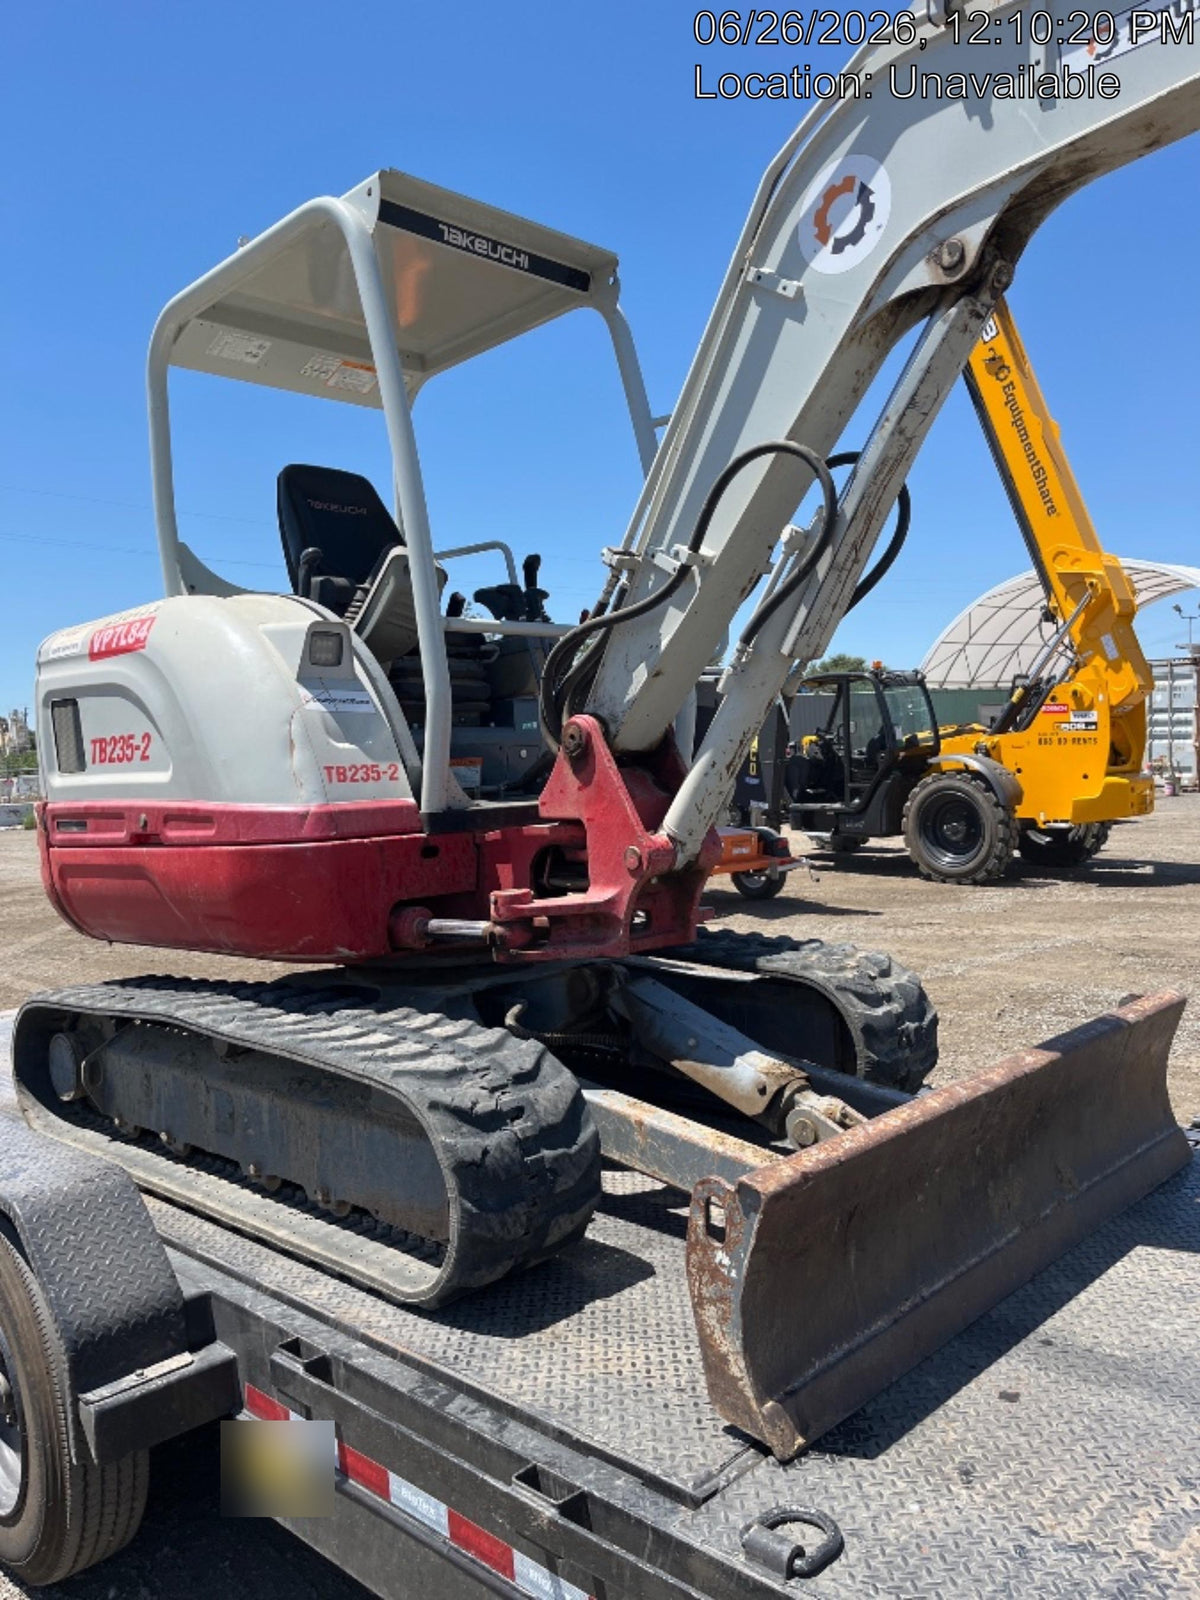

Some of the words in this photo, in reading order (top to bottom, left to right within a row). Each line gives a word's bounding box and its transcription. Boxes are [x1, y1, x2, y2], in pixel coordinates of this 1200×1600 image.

[1002, 381, 1057, 517] EquipmentShare
[90, 732, 152, 765] TB235-2
[322, 763, 400, 784] TB235-2
